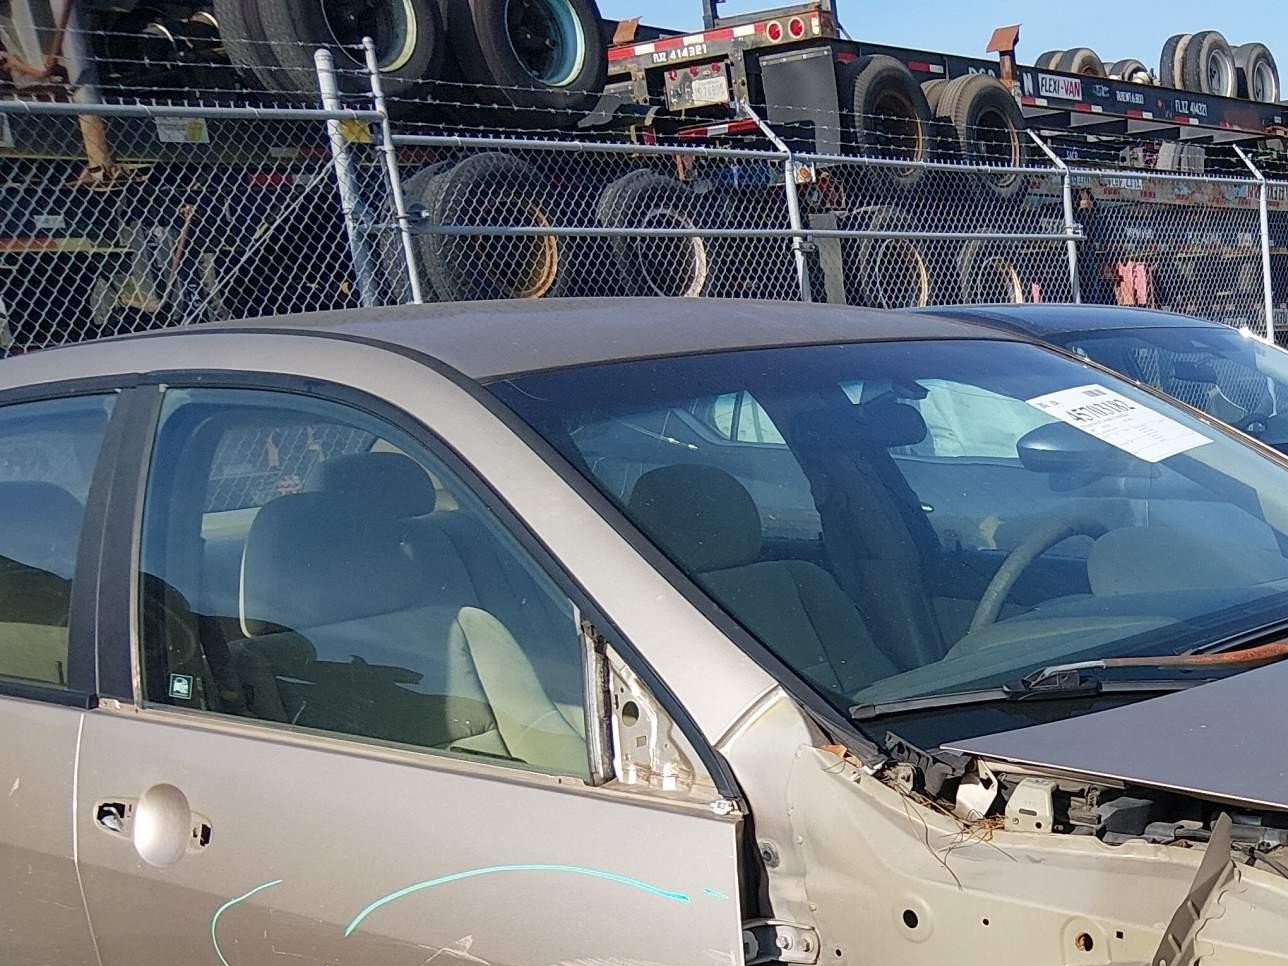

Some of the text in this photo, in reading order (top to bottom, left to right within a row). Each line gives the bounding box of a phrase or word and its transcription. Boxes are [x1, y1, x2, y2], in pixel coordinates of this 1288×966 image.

[670, 44, 707, 58] 414321
[1040, 76, 1081, 98] FLEXI-VAN
[1065, 399, 1135, 422] 45703182
